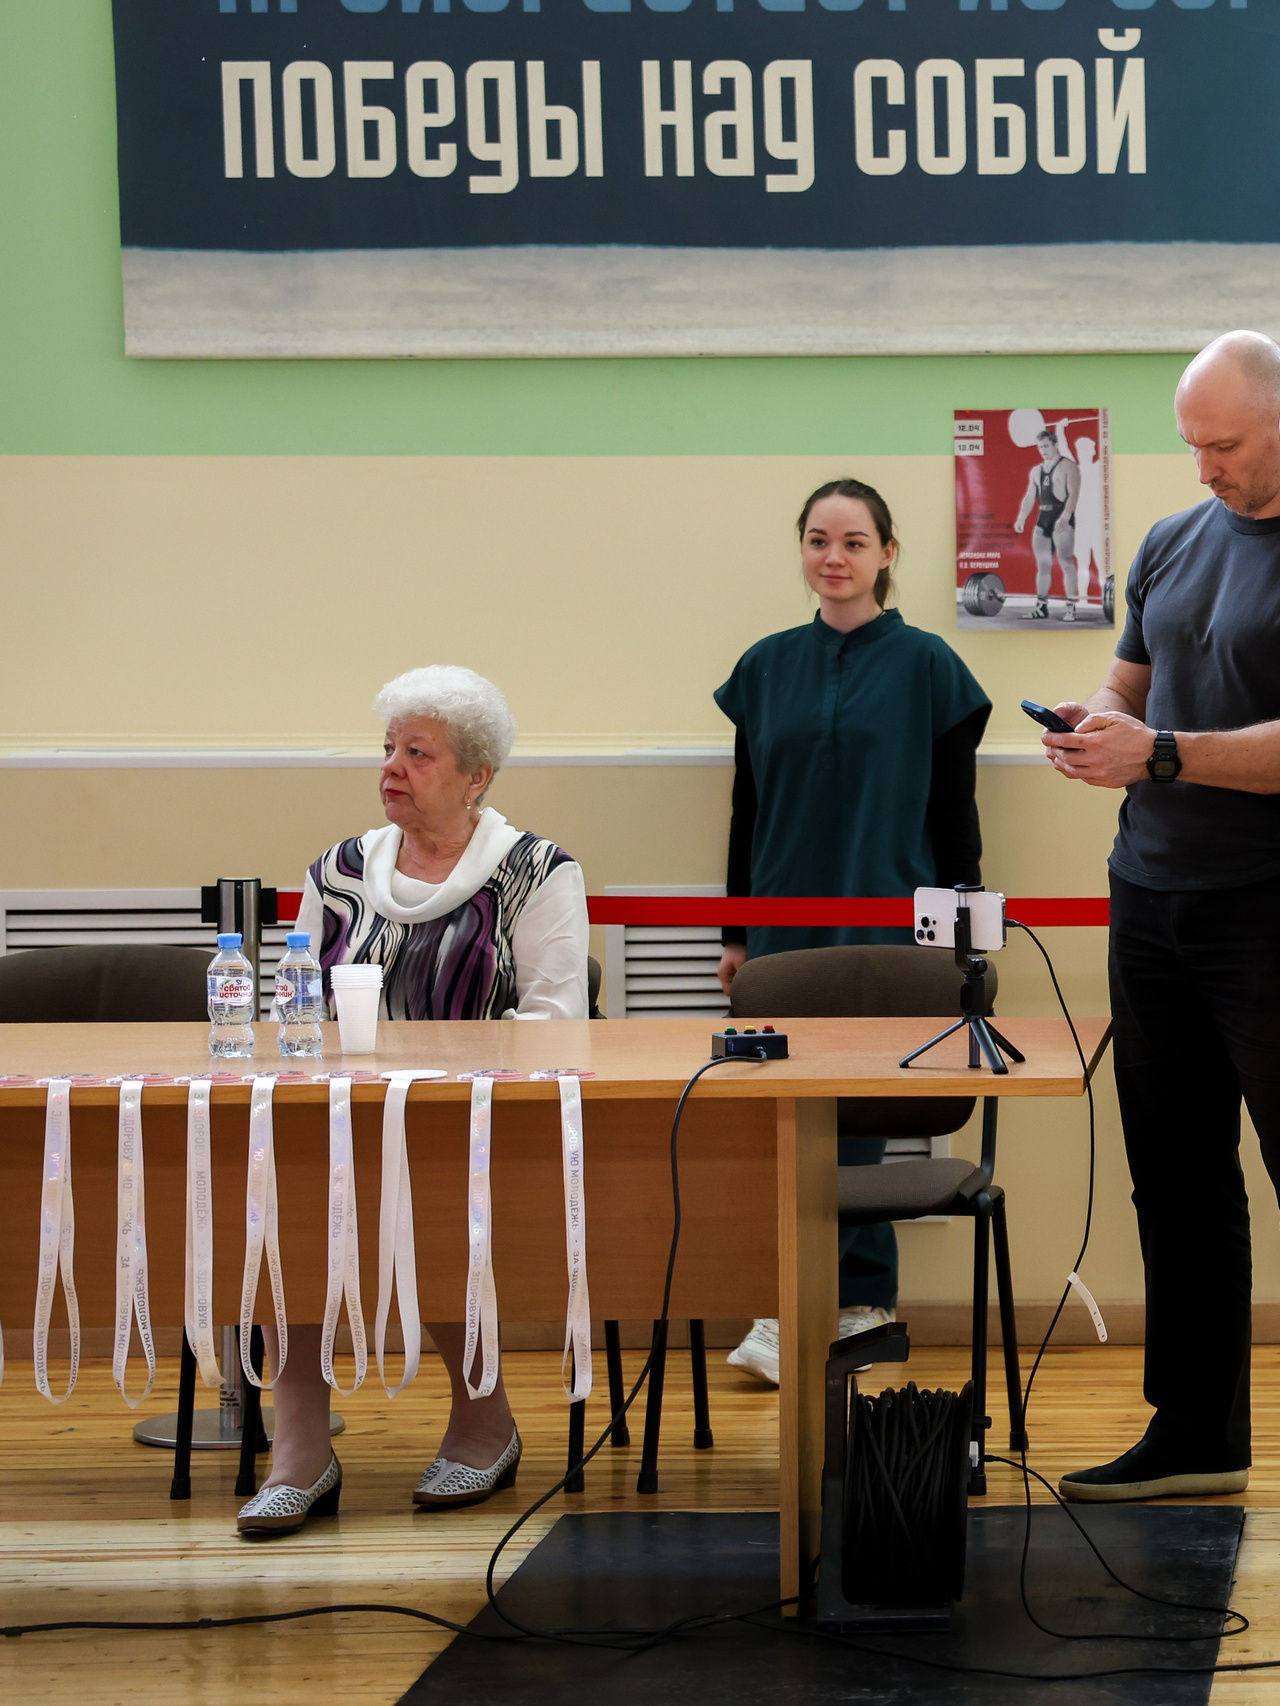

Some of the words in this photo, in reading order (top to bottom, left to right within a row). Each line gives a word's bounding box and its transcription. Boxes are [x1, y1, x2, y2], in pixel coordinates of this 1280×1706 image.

[853, 28, 1147, 176] СОБОЙ
[958, 424, 980, 432] 12.04
[124, 1095, 136, 1109] ЗА
[193, 1092, 205, 1106] ЗА
[192, 1109, 205, 1168] ЗДОРОВУЮ
[569, 1169, 581, 1231] МОЛОДЁЖЬ
[44, 1254, 54, 1267] ЗА
[120, 1256, 130, 1269] ЗА
[473, 1254, 482, 1268] ЗА
[573, 1250, 580, 1265] ЗА
[332, 1259, 341, 1272] ЗА
[242, 1262, 257, 1319] ЗДОРОВУЮ
[37, 1271, 53, 1328] ЗДОРОВУЮ
[197, 1270, 208, 1329] ЗДОРОВУЮ
[469, 1271, 481, 1329] ЗДОРОВУЮ
